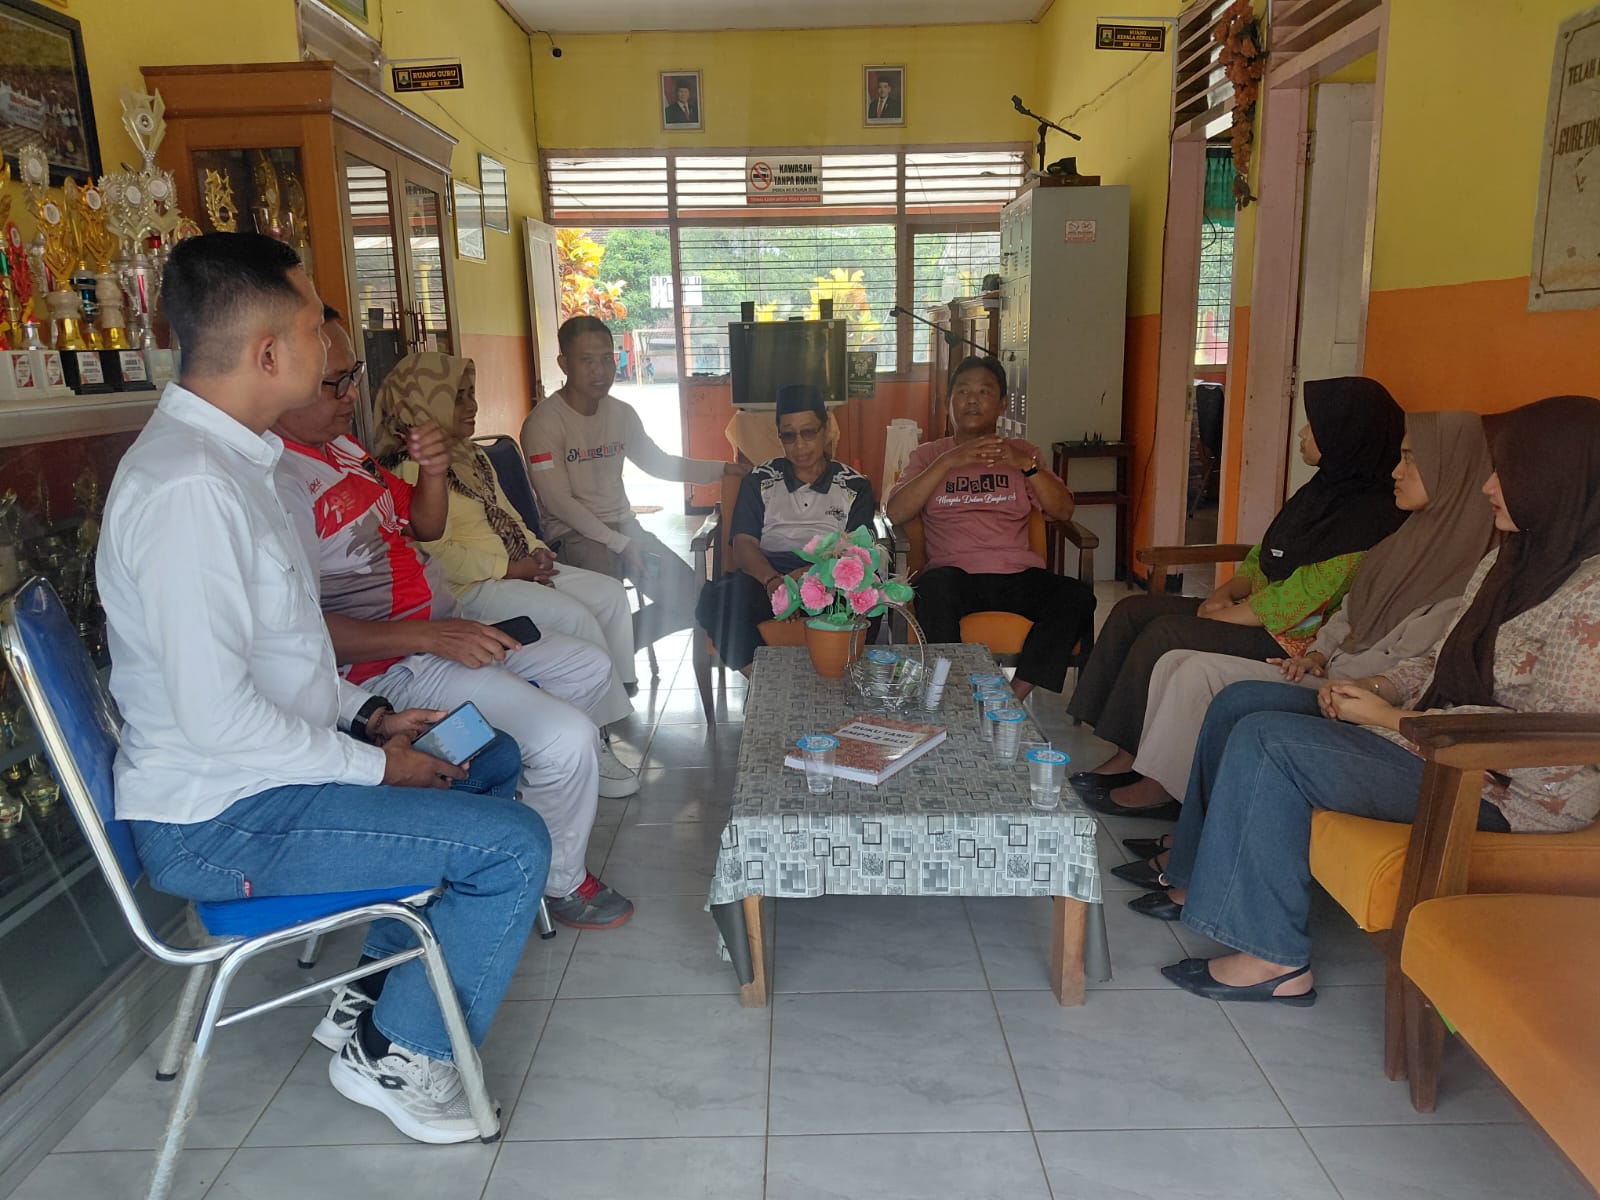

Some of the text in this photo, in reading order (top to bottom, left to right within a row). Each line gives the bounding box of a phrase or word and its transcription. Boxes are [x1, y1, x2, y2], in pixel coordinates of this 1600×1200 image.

[412, 71, 436, 79] RUANG
[779, 164, 813, 173] KAWASAN
[774, 175, 818, 185] TANPA ROKOK
[852, 725, 914, 739] BUKU TAMU
